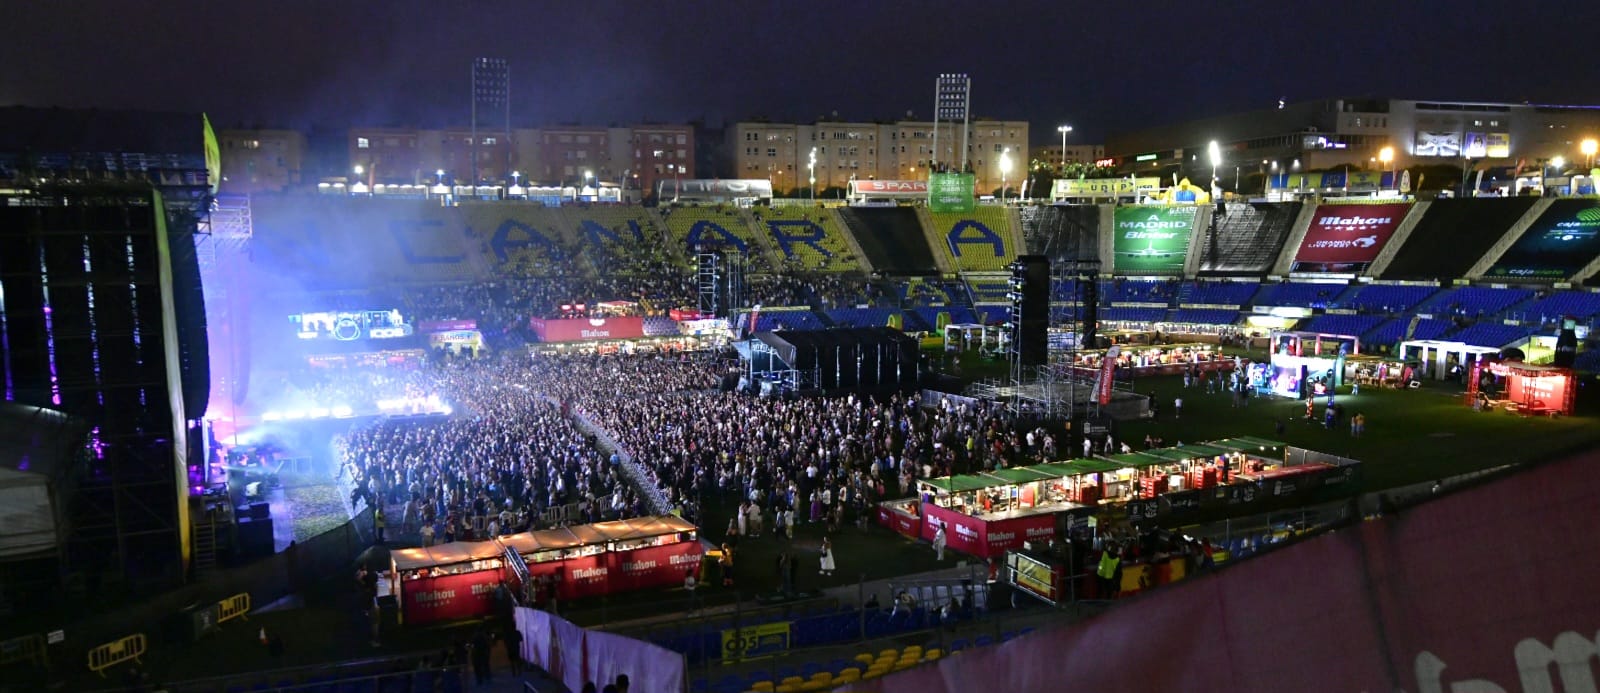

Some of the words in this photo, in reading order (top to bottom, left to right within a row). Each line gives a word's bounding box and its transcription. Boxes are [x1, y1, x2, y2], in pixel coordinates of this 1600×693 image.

[873, 182, 926, 190] SPAR
[1319, 216, 1391, 225] Mahou
[1124, 231, 1178, 239] Binter
[987, 532, 1015, 542] Mahou
[1026, 527, 1054, 537] Mahou
[623, 560, 656, 571] Mahou
[573, 567, 608, 579] Mahou
[416, 590, 456, 603] Mahou
